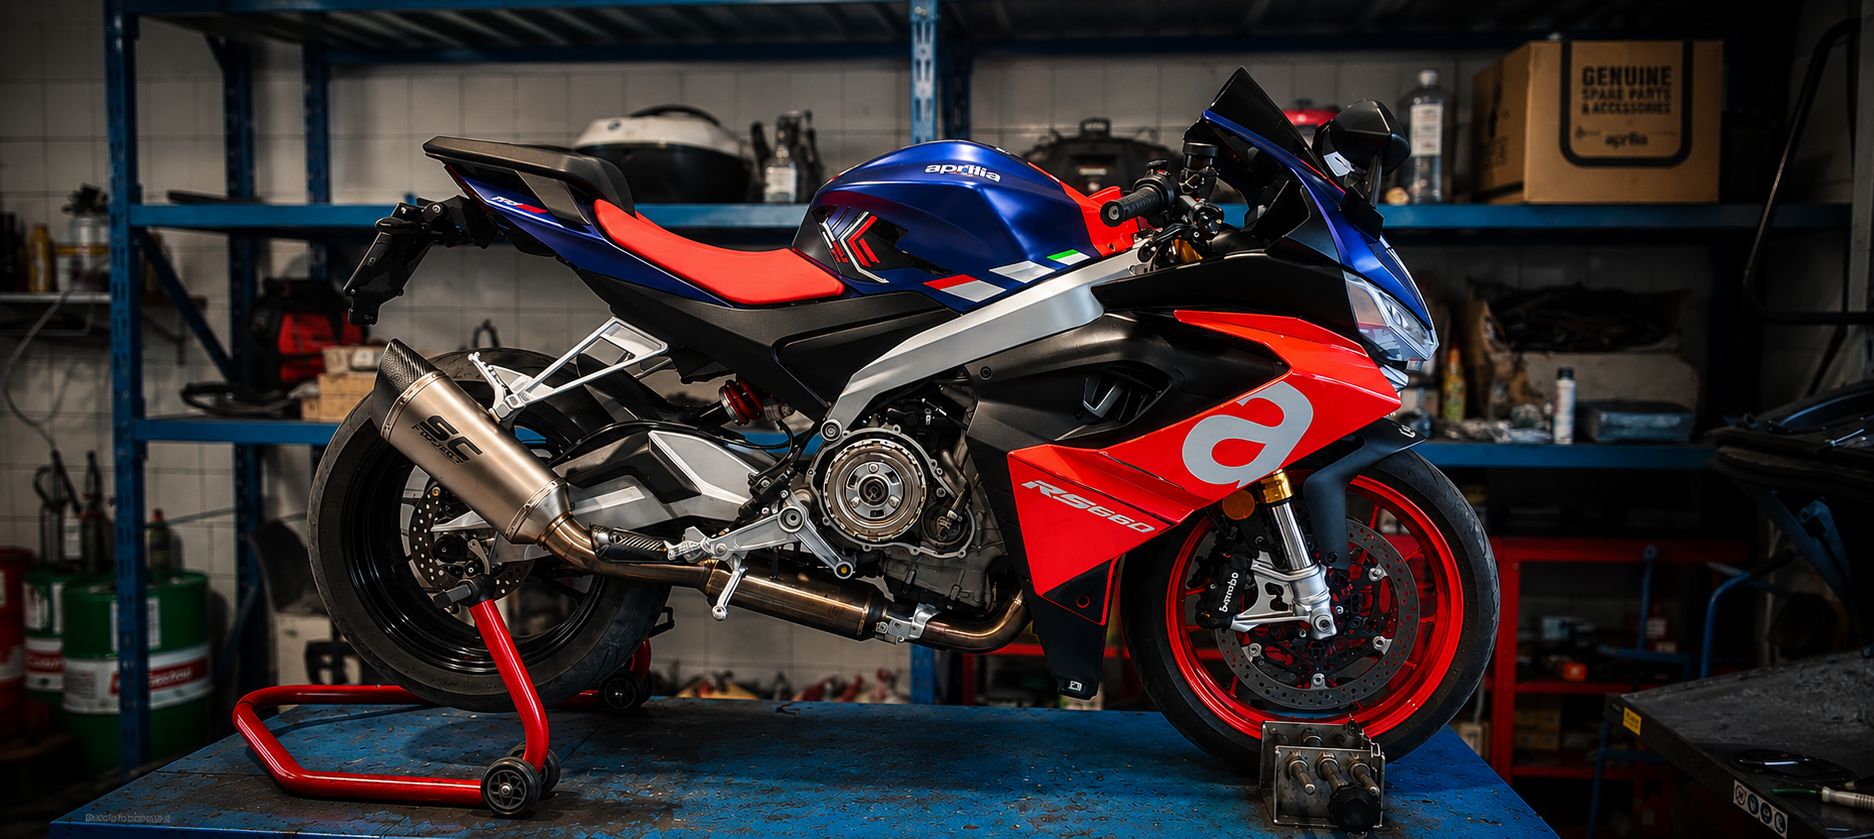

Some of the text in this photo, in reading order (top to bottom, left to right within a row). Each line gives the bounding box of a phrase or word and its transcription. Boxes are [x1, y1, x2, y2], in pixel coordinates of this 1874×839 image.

[1583, 65, 1672, 86] GENUINE
[1582, 86, 1672, 101] SPARE PARTS
[1582, 102, 1672, 115] & ACCESSORIES
[1605, 131, 1648, 148] aprilia
[925, 164, 1001, 183] aprilia
[418, 415, 483, 462] SC
[1021, 480, 1156, 533] RS660
